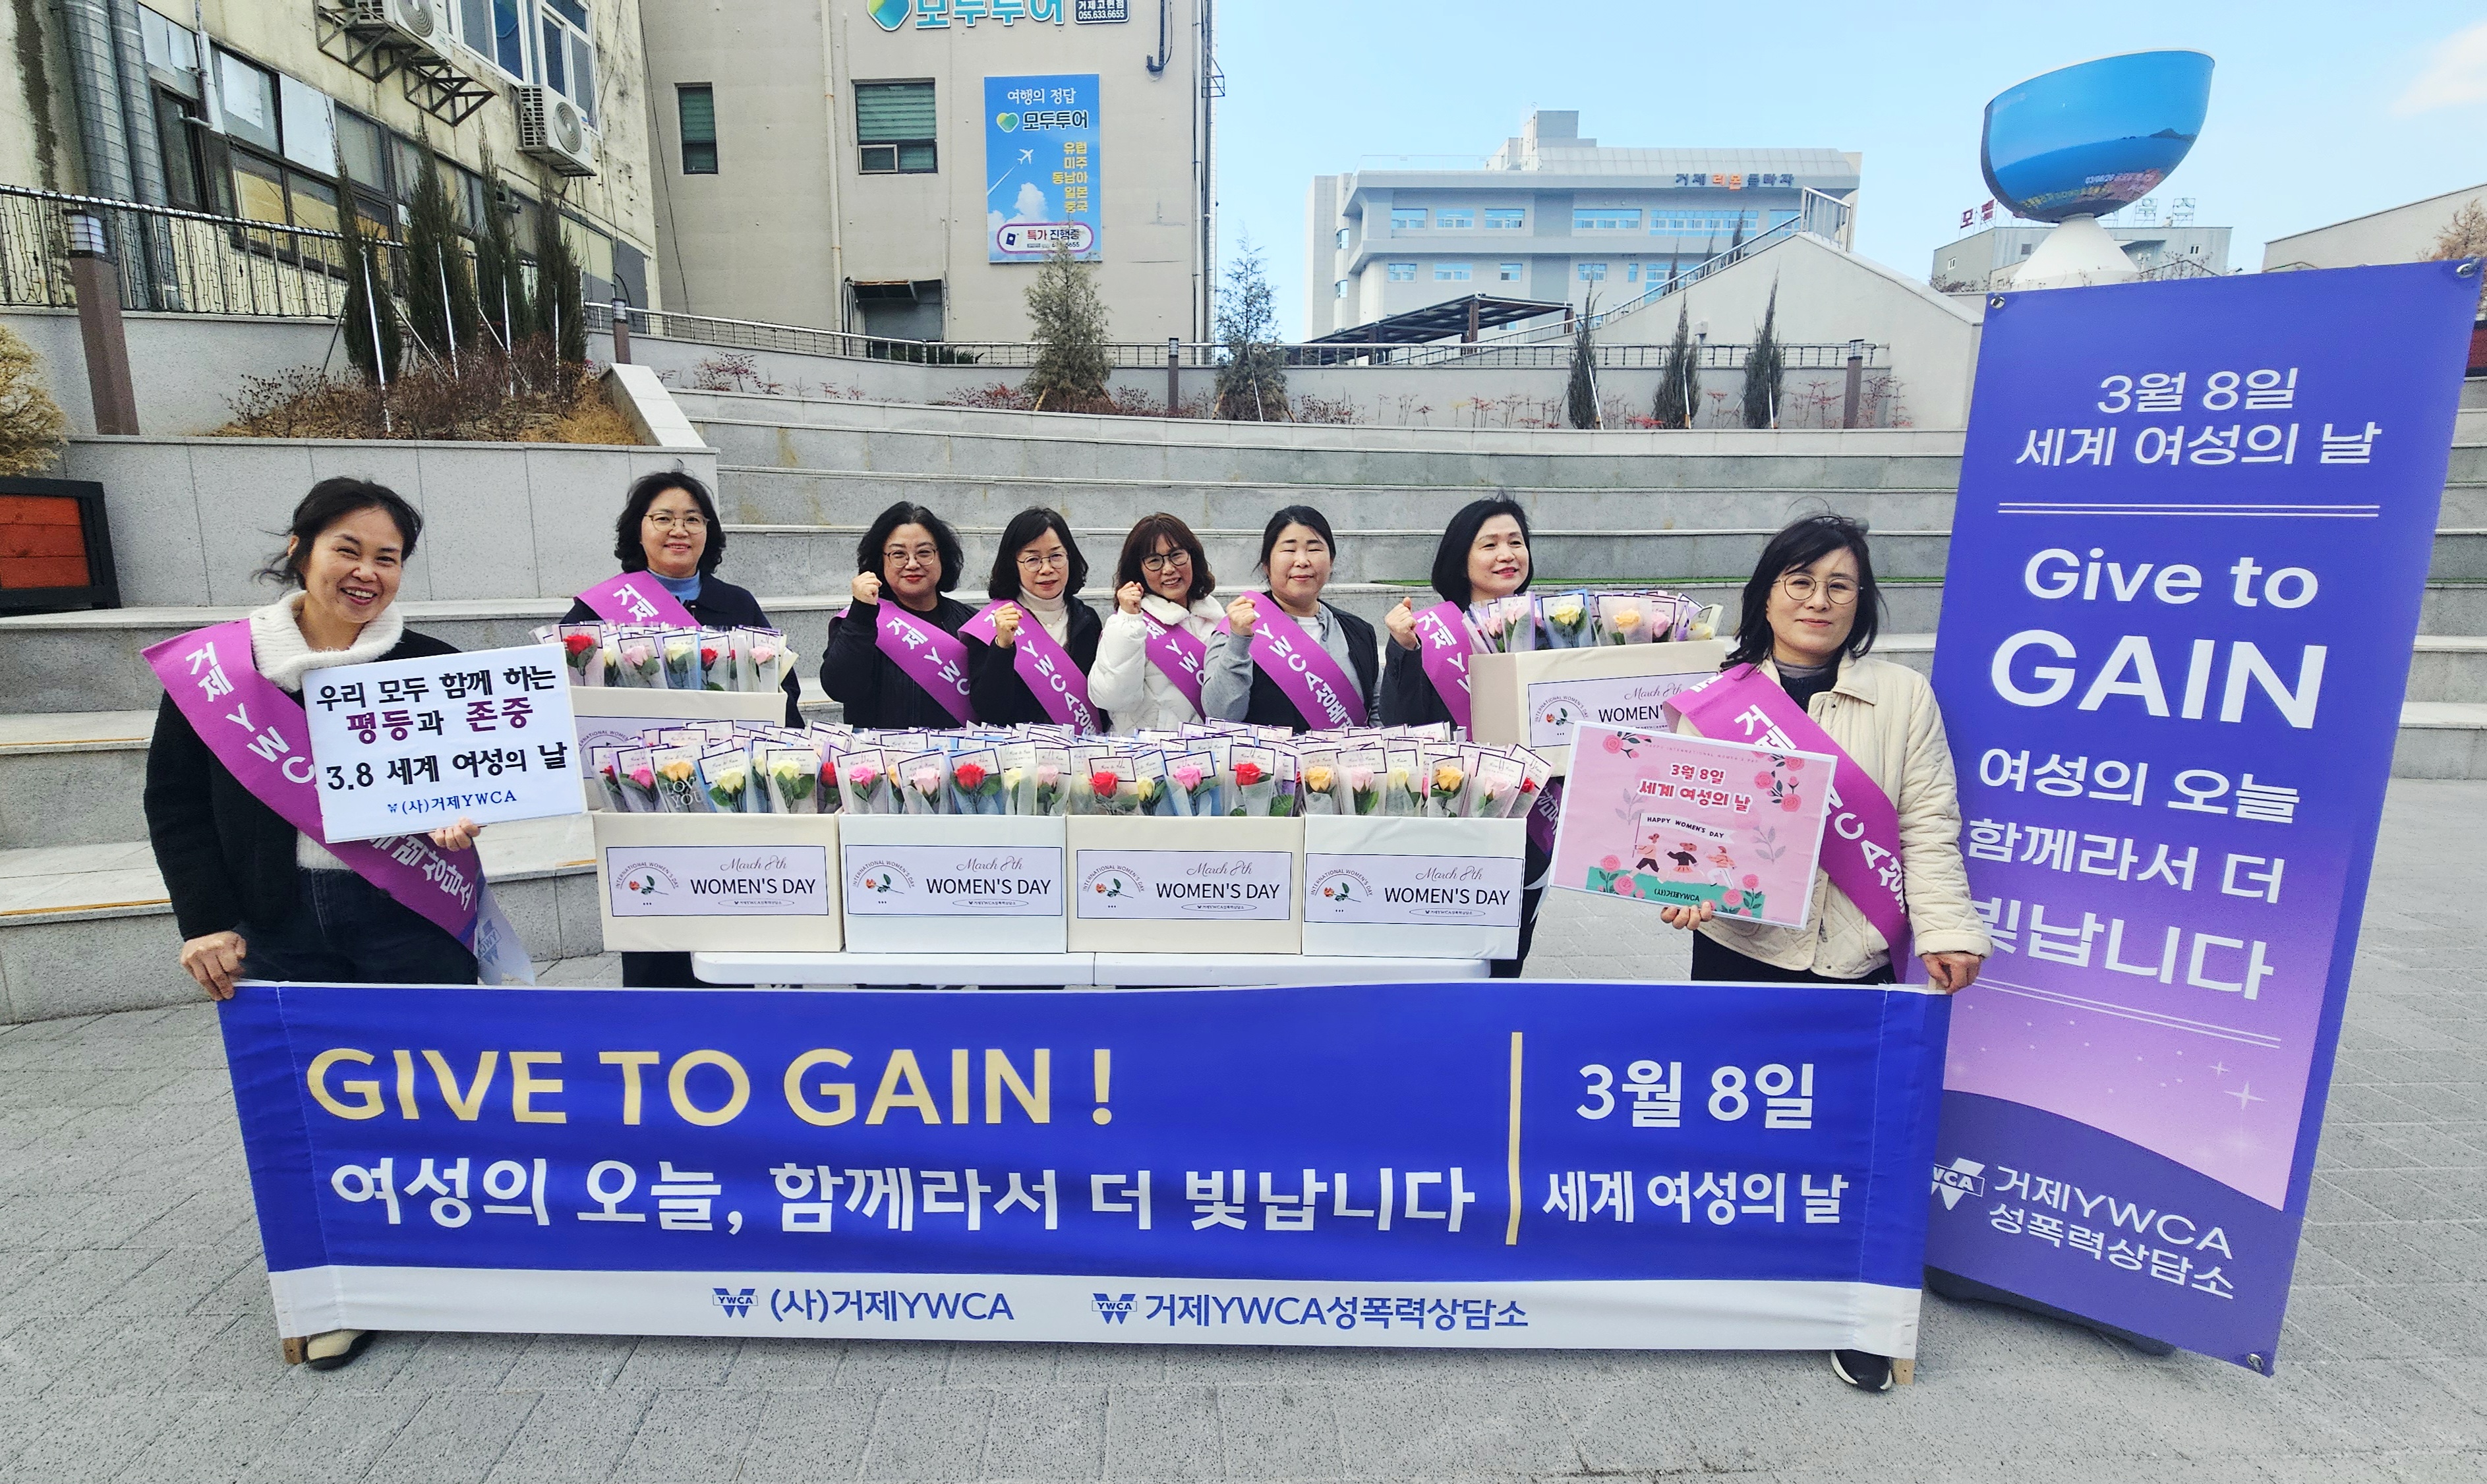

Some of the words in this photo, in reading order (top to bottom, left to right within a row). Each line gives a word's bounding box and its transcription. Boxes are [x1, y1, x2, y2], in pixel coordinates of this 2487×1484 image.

[1078, 9, 1125, 20] 055.633.6655
[1007, 88, 1045, 105] 여행의
[1050, 88, 1076, 104] 정답
[1023, 109, 1088, 131] 모두투어
[1064, 141, 1087, 154] 유럽
[1064, 156, 1088, 169] 미주
[1052, 171, 1088, 184] 동남아
[1065, 186, 1088, 198] 일본
[1065, 200, 1088, 213] 중국
[1027, 229, 1047, 241] 특가
[1050, 229, 1080, 241] 진행중
[2098, 372, 2187, 413] 3월
[2202, 367, 2298, 411] 8일
[2016, 427, 2117, 467] 세계
[2134, 423, 2299, 466] 여성의
[2320, 421, 2382, 465] 날
[2024, 548, 2202, 604] Give
[2230, 557, 2319, 609] to
[612, 583, 659, 621] 거제
[316, 682, 366, 712] 우리
[378, 677, 429, 703] 모두
[439, 670, 493, 699] 함께
[503, 666, 556, 692] 하는
[1991, 629, 2327, 729] GAIN
[1624, 687, 1660, 700] March
[346, 709, 444, 745] 평등과
[466, 697, 533, 732] 존중
[225, 702, 317, 790] YWC
[326, 762, 374, 790] 3.8
[387, 755, 440, 785] 세계
[452, 748, 527, 778] 여성의
[538, 741, 568, 770] 날
[1672, 764, 1695, 780] 3월
[1699, 768, 1724, 784] 8일
[1639, 780, 1675, 797] 세계
[1680, 787, 1729, 806] 여성의
[1735, 794, 1751, 812] 날
[1979, 748, 2149, 806] 여성의
[2167, 769, 2300, 824] 오늘
[402, 789, 517, 814] (사)거제YWCA
[1675, 820, 1706, 833] WOMEN'S
[720, 857, 761, 872] March
[765, 855, 787, 870] 8th
[852, 860, 884, 886] INTERNATIONAL
[956, 857, 997, 872] March
[1000, 855, 1023, 871] 8th
[1186, 862, 1228, 876] March
[1230, 860, 1252, 876] 8th
[1415, 867, 1457, 882] March
[1459, 865, 1482, 881] 8th
[1968, 818, 2199, 891] 함께라서
[2221, 853, 2285, 903] 더
[616, 862, 647, 888] INTERNATIONAL
[690, 878, 777, 894] WOMEN'S
[783, 879, 815, 894] DAY
[926, 878, 1012, 894] WOMEN'S
[1018, 879, 1051, 894] DAY
[1082, 865, 1115, 892] INTERNATIONAL
[1310, 869, 1344, 895] INTERNATIONAL
[1156, 883, 1241, 898] WOMEN'S
[1246, 884, 1280, 899] DAY
[1384, 888, 1470, 904] WOMEN'S
[1476, 890, 1510, 905] DAY
[1971, 898, 2274, 1000] 빛납니다
[307, 1048, 567, 1124] GIVE
[599, 1050, 750, 1127] TO
[784, 1048, 1051, 1126] GAIN
[1577, 1060, 1683, 1128] 3월
[1707, 1063, 1815, 1129] 8일
[1933, 1165, 1974, 1191] WCA
[332, 1157, 550, 1228] 여성의
[577, 1160, 743, 1234] 오늘,
[770, 1162, 1057, 1232] 함께라서
[1091, 1170, 1152, 1230] 더
[1186, 1167, 1475, 1232] 빛납니다
[1542, 1171, 1634, 1223] 세계
[1647, 1172, 1786, 1226] 여성의
[1801, 1174, 1850, 1224] 날
[1995, 1165, 2233, 1260] 거제YWCA
[1989, 1203, 2234, 1299] 성폭력상담소
[717, 1296, 753, 1305] YWCA
[771, 1288, 1014, 1323] (사)거제YWCA
[1145, 1294, 1529, 1331] 거제YWCA성폭력상담소
